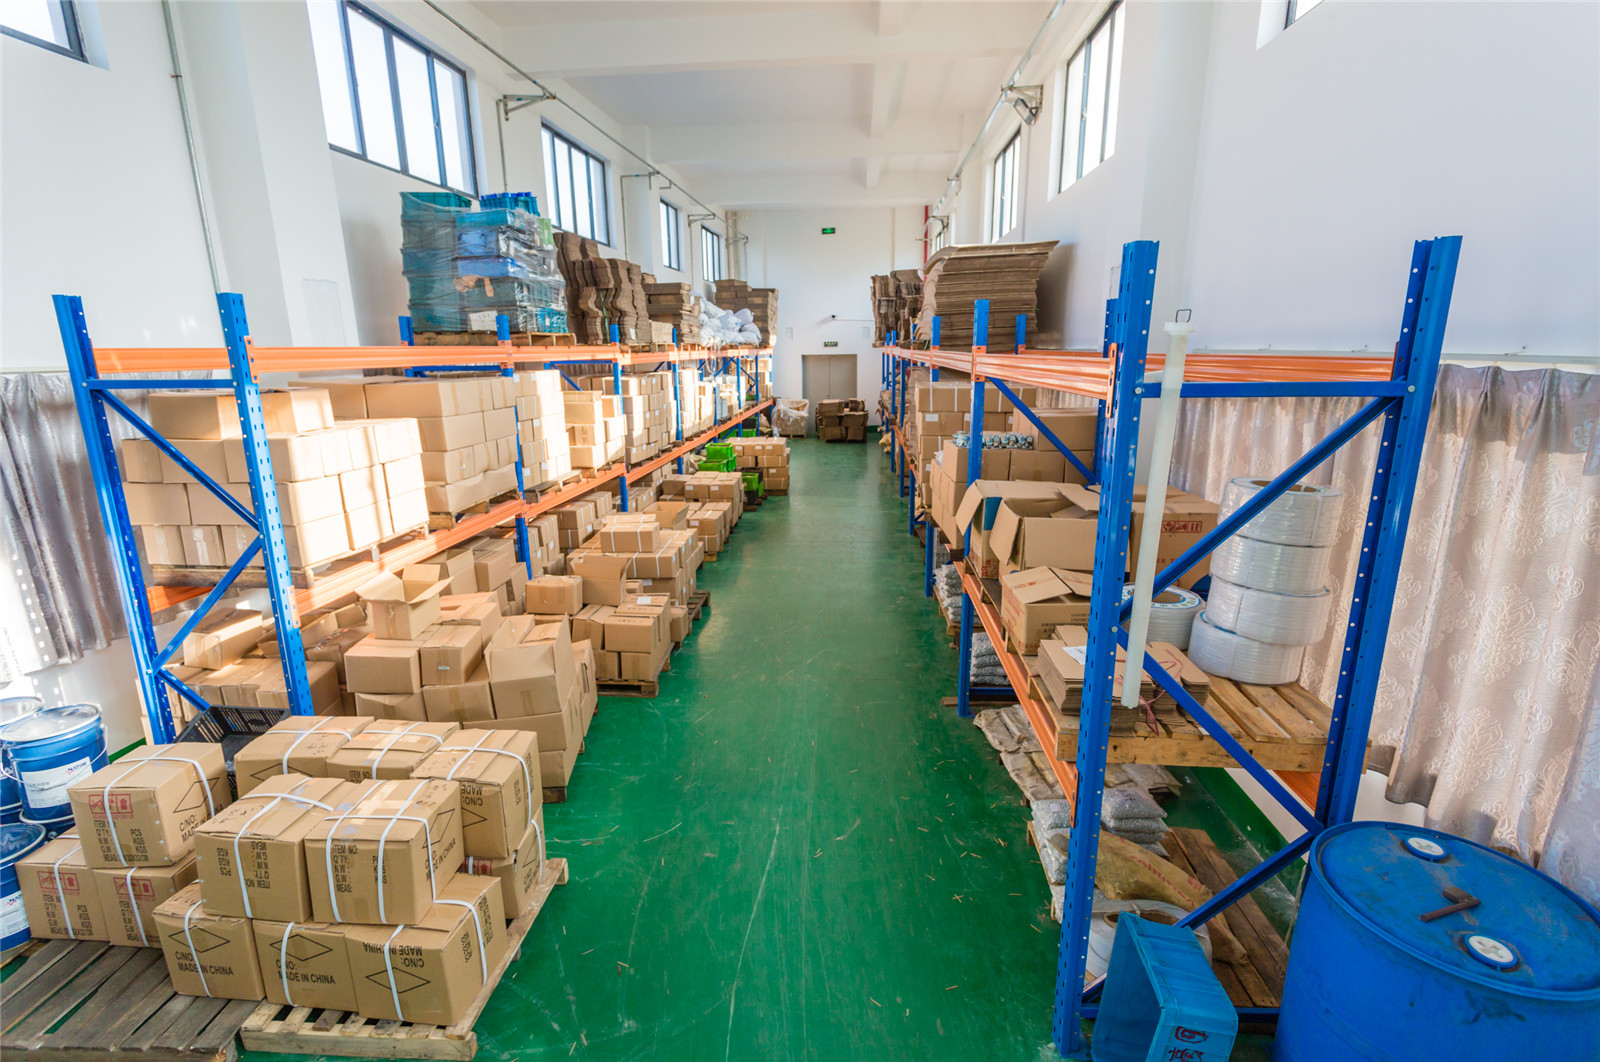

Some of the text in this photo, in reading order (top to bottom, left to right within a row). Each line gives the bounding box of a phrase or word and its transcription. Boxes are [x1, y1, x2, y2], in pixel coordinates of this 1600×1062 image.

[461, 784, 484, 796] MADE
[332, 844, 346, 855] ITEM
[398, 945, 423, 956] MADE
[177, 962, 199, 974] MADE
[208, 965, 234, 976] CHINA
[300, 972, 309, 983] IN
[310, 973, 336, 985] CHINA
